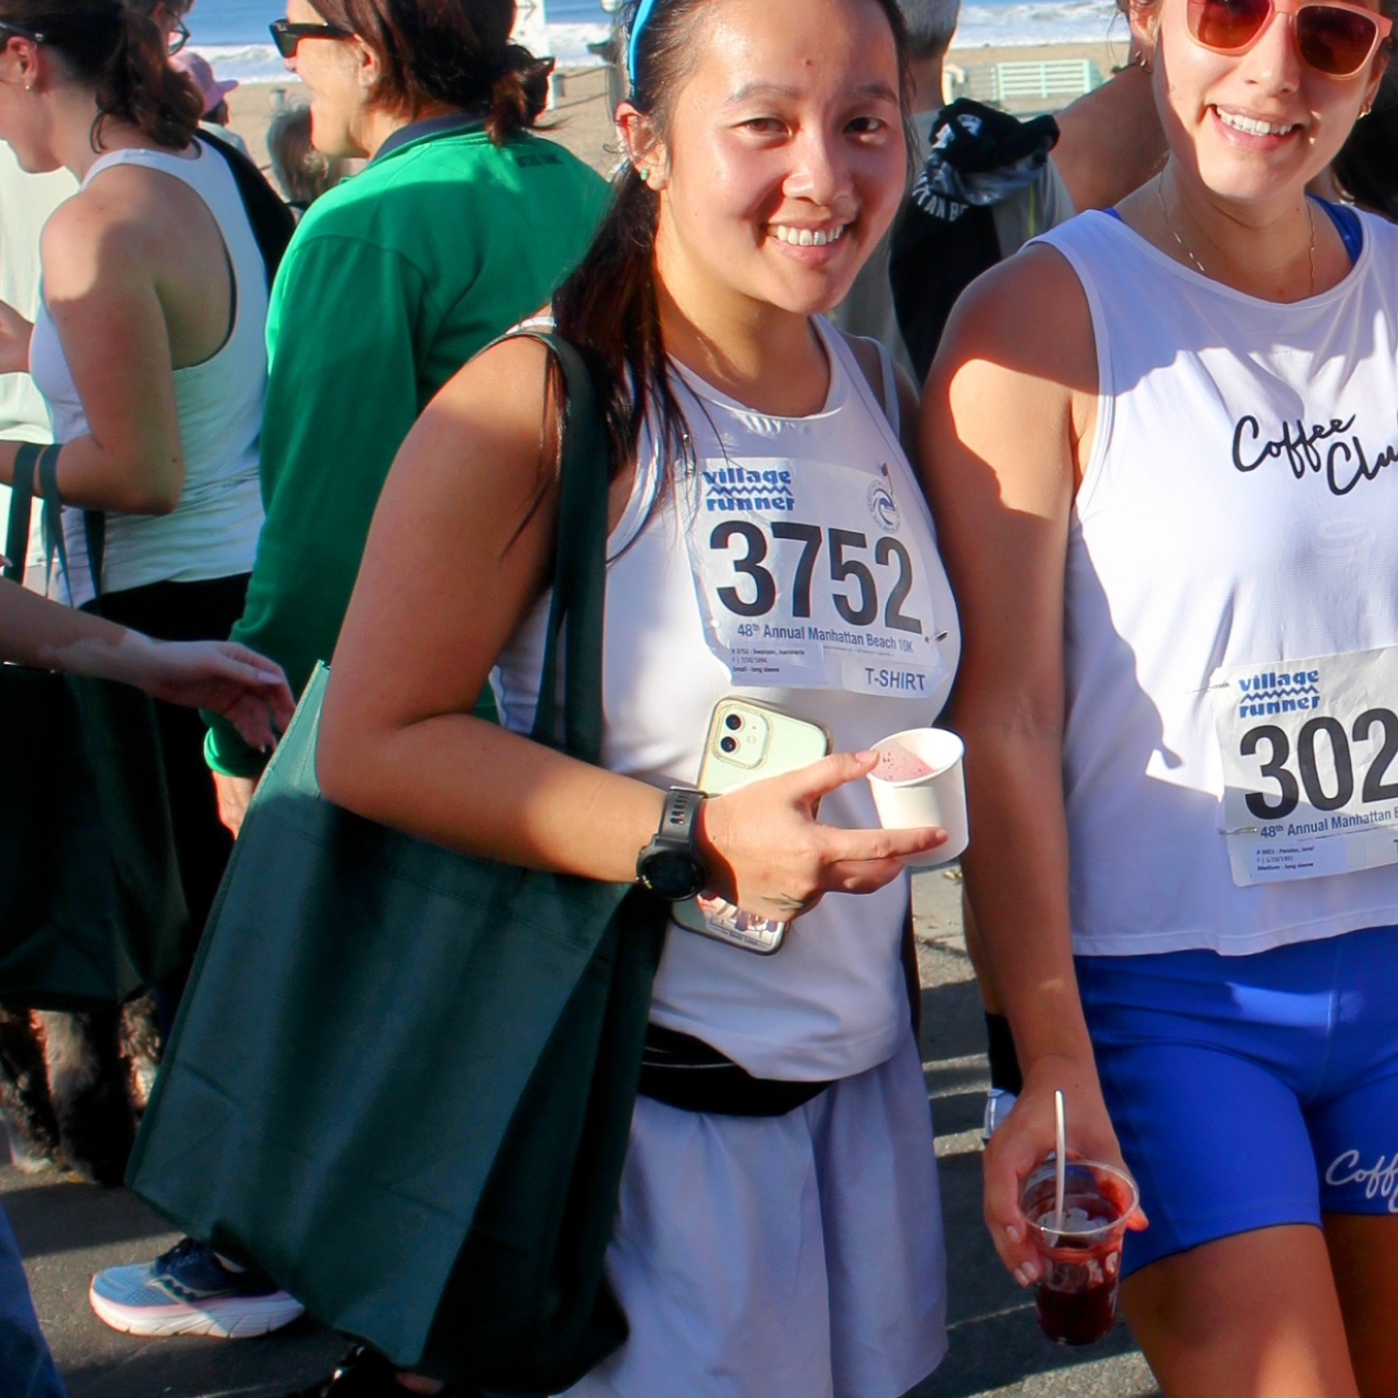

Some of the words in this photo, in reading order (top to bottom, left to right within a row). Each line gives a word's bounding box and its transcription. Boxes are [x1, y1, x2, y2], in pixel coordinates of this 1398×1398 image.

[1232, 414, 1356, 479] Coffee
[702, 468, 791, 485] village
[706, 497, 795, 512] runner
[710, 520, 922, 635] 3752
[737, 624, 760, 637] 48th
[764, 625, 804, 640] Annual
[808, 627, 864, 646] Manhattan
[866, 634, 896, 650] Beach
[898, 639, 913, 653] 10K
[865, 667, 926, 690] T-SHIRT
[1238, 670, 1319, 691] village
[1239, 695, 1321, 718] runner
[1260, 824, 1284, 838] 48th
[1287, 818, 1328, 837] Annual
[1331, 809, 1392, 830] Manhattan
